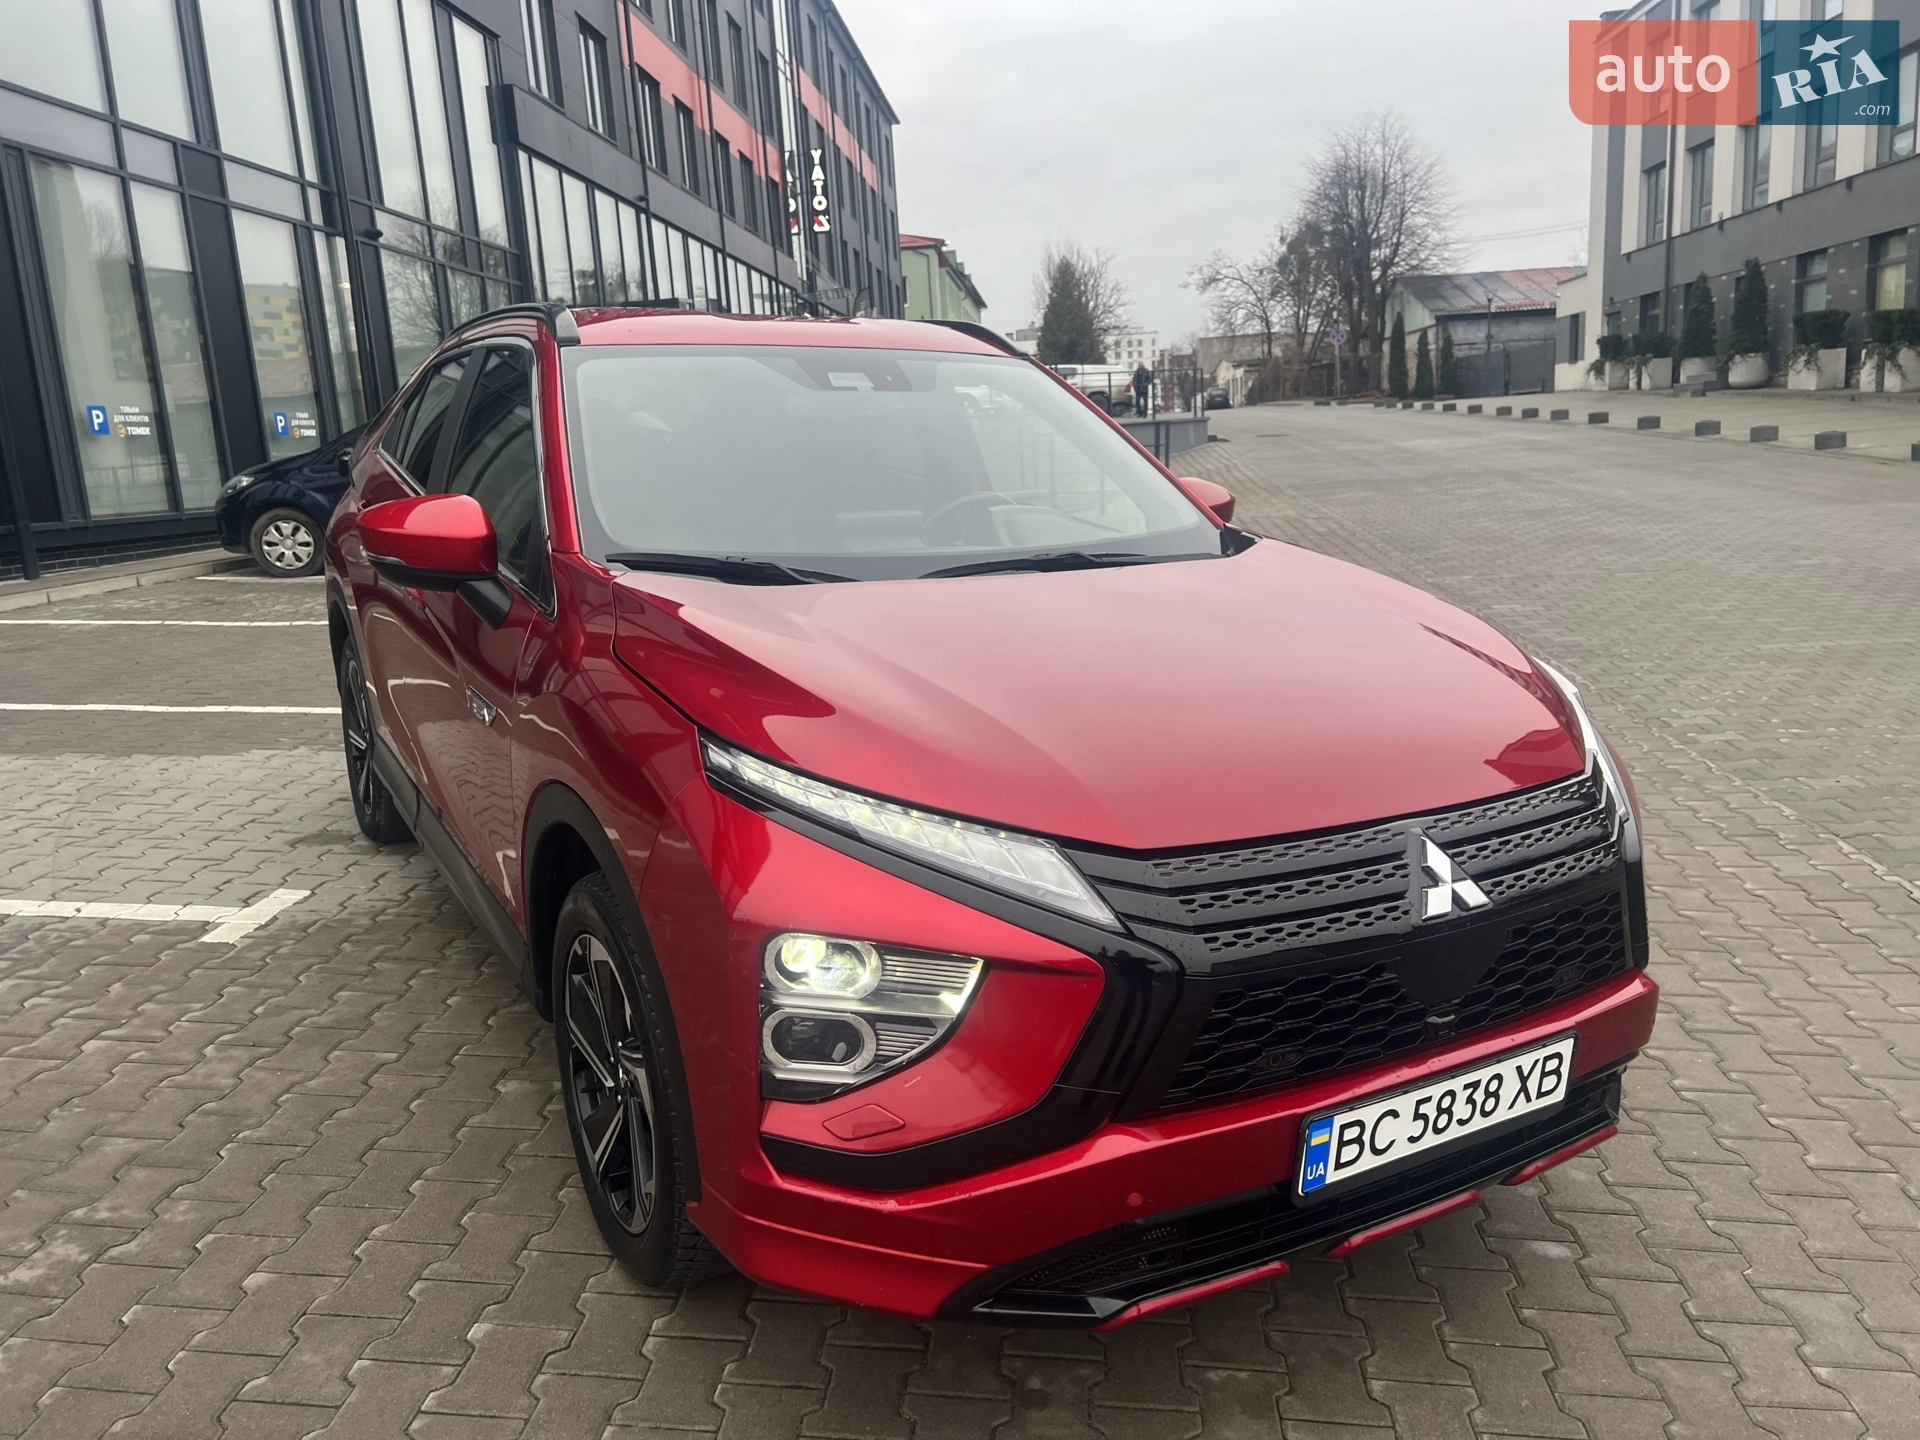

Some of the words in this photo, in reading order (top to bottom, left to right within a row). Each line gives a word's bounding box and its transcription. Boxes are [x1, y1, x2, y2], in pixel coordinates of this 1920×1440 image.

[810, 148, 828, 211] YATO
[91, 409, 104, 431] P
[276, 414, 286, 433] P
[1333, 1108, 1401, 1172] BC
[1407, 1072, 1504, 1144] 5838
[1507, 1051, 1564, 1111] XB
[1307, 1161, 1325, 1180] UA
